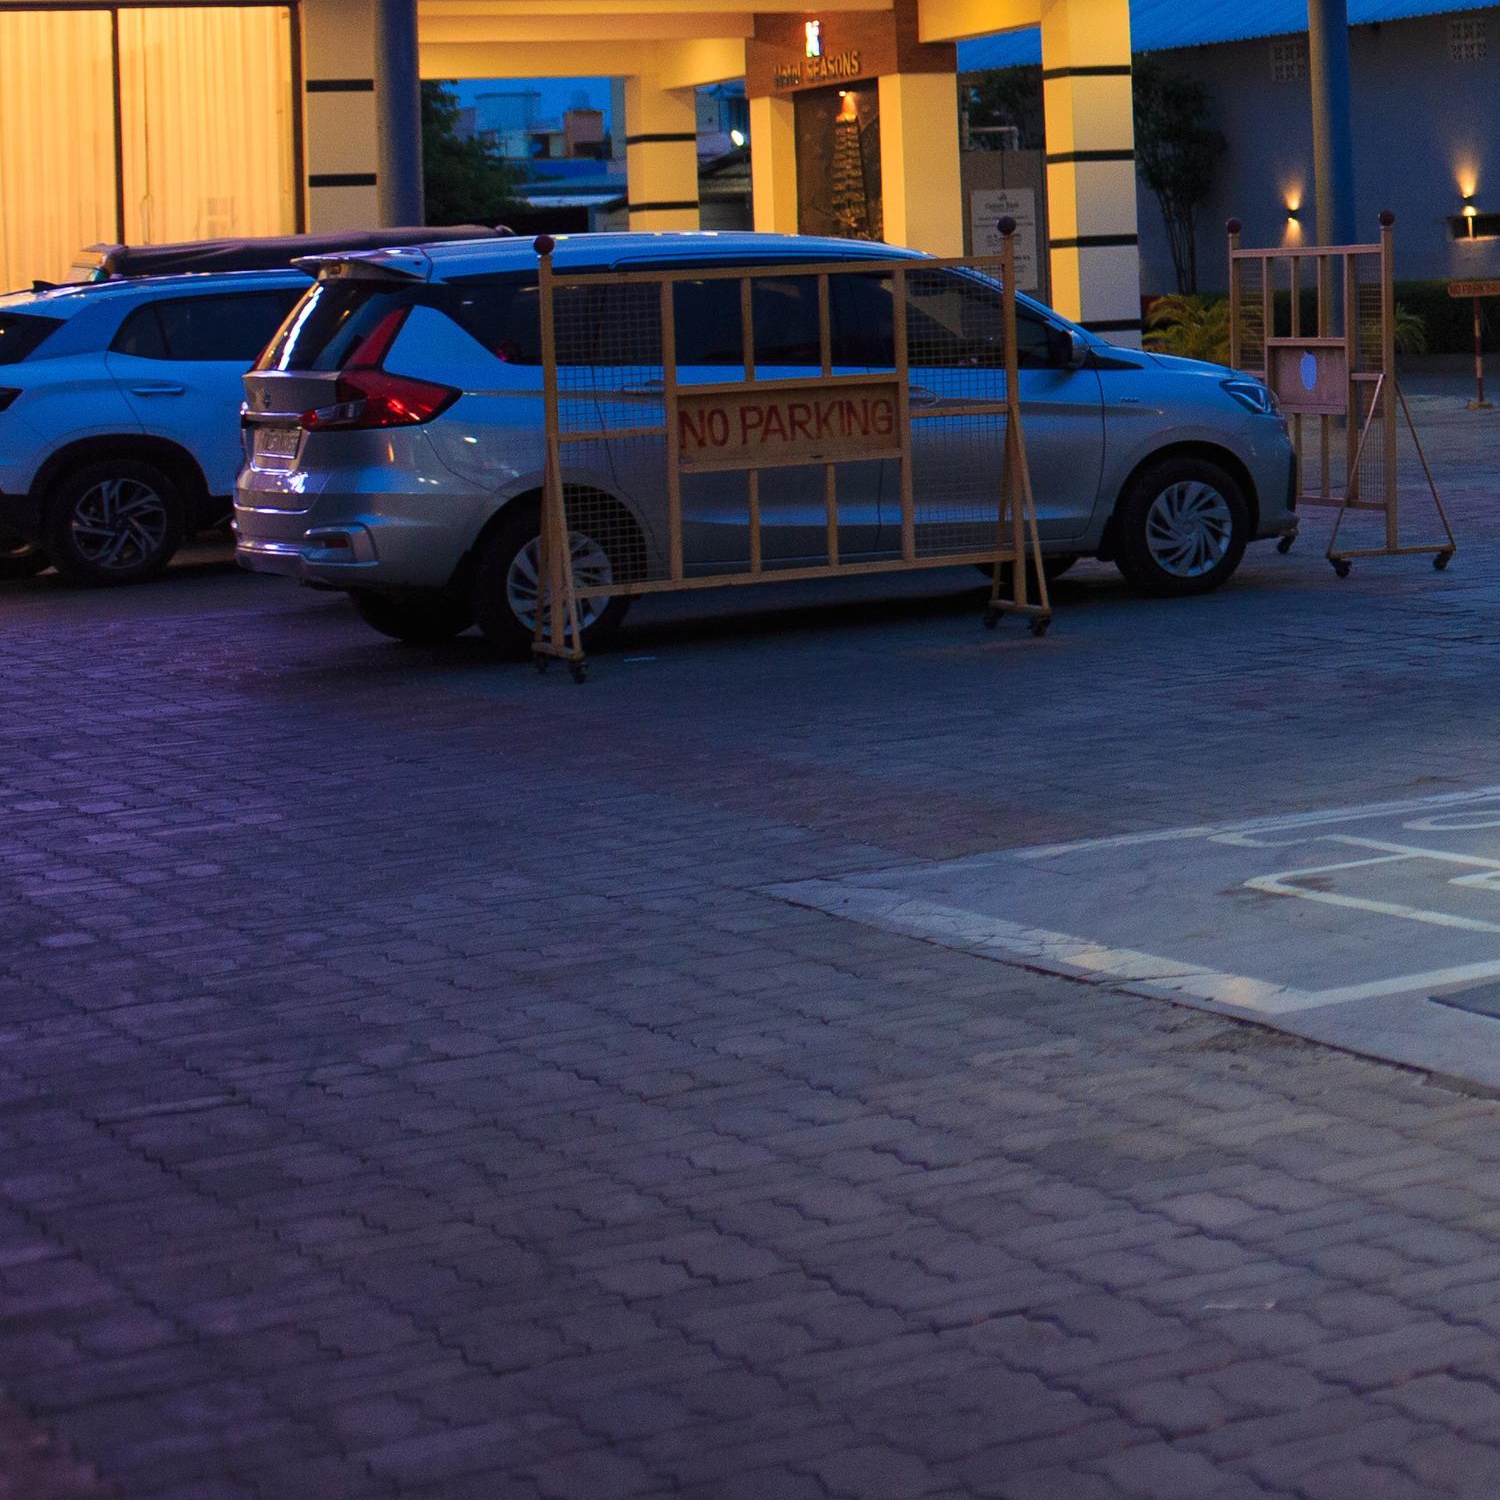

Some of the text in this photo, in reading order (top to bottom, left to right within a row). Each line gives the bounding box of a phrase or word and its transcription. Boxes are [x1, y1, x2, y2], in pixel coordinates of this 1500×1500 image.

[805, 51, 860, 82] SEASONS
[678, 399, 894, 449] NO PARKING
